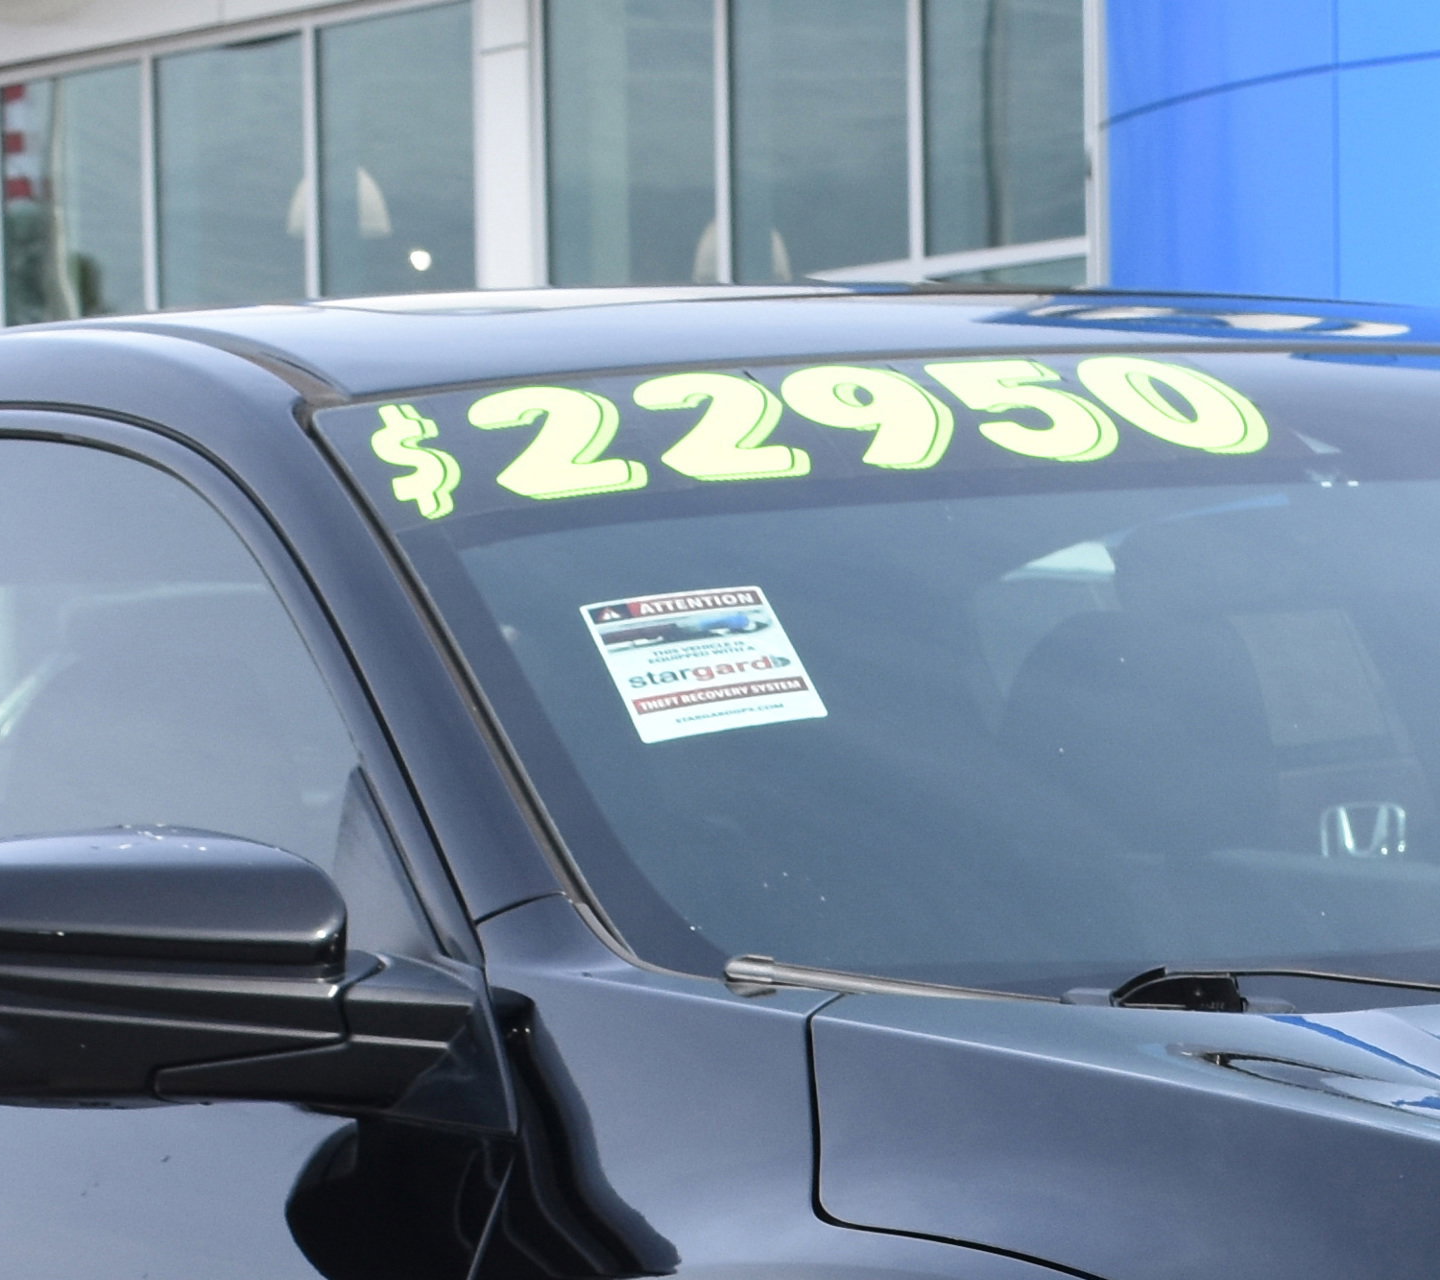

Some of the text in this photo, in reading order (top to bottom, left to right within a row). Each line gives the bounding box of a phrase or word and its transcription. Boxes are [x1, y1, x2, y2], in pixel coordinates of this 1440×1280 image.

[370, 356, 1270, 521] $22950
[640, 593, 754, 614] ATTENTION
[682, 642, 733, 653] VEHICLE
[629, 655, 772, 689] stargard
[638, 679, 802, 712] THEFT RECOVERY SYSTEM
